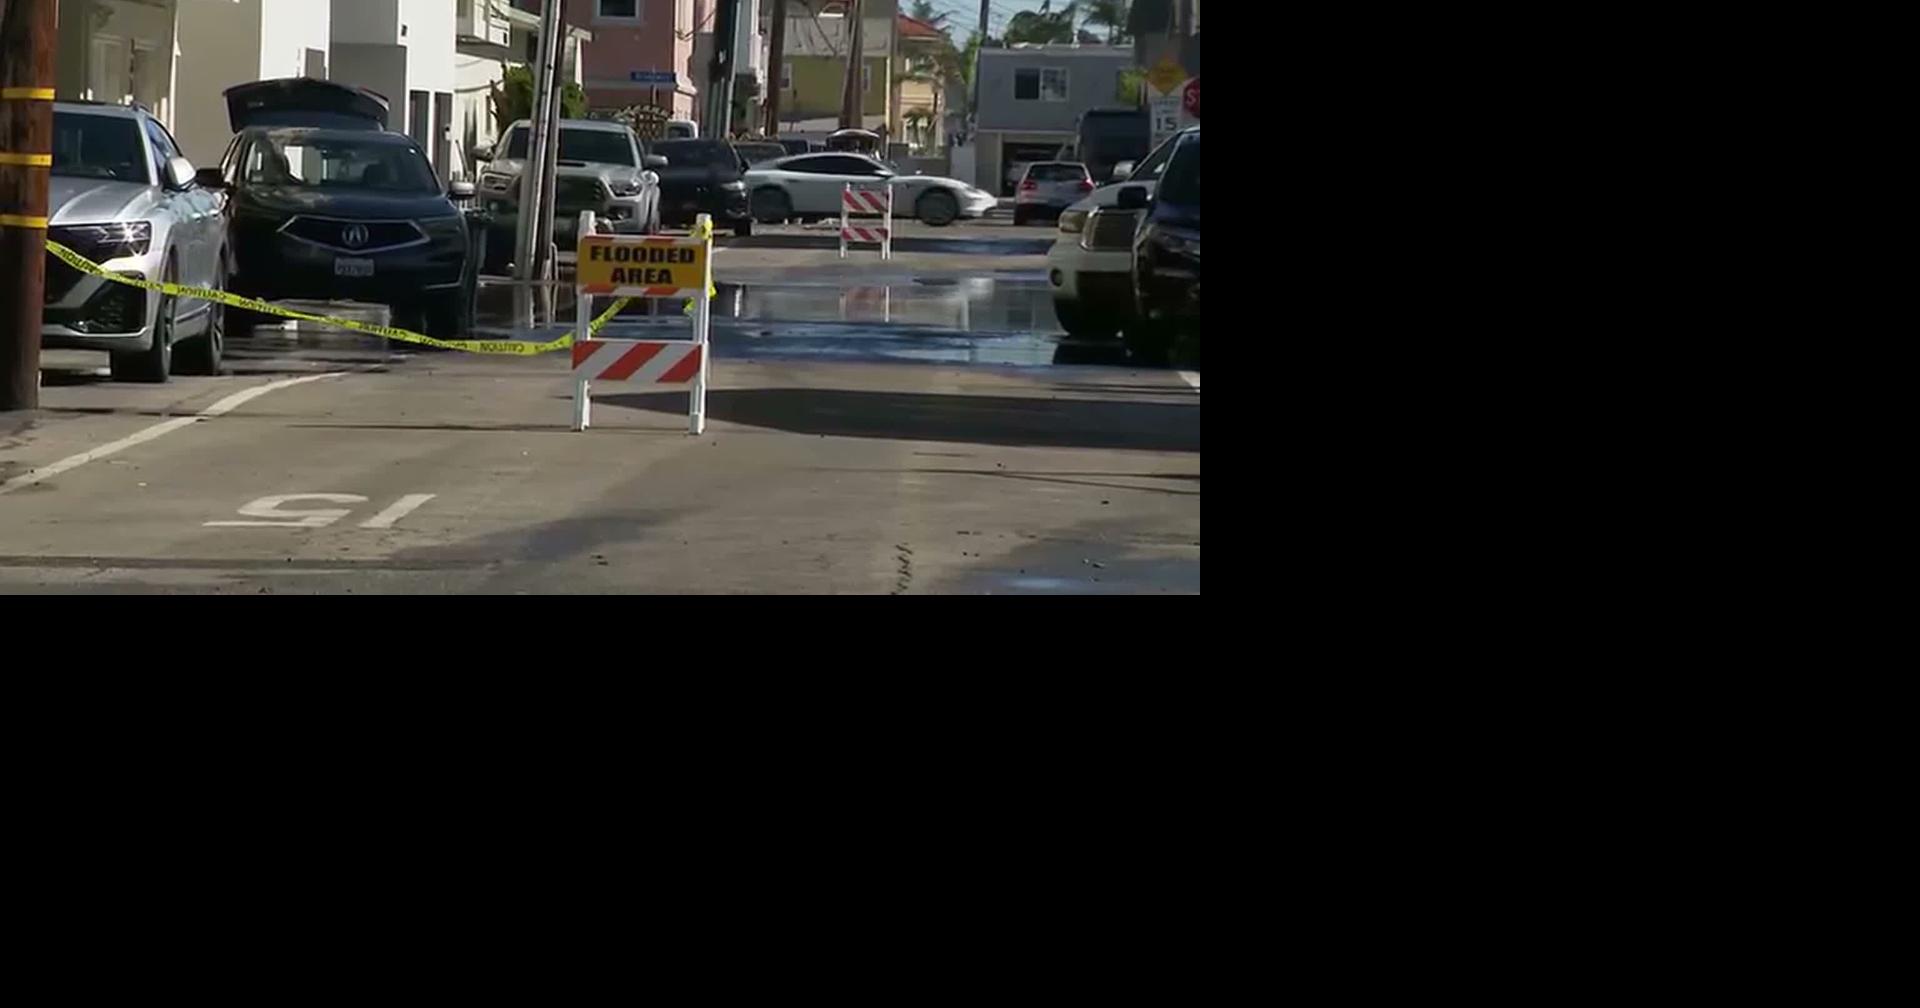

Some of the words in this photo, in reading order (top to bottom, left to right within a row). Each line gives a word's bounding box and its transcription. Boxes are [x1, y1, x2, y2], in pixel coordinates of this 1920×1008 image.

[1156, 118, 1177, 131] 15
[589, 245, 695, 264] FLOODED
[610, 267, 673, 285] AREA
[479, 340, 526, 354] CAUTION
[202, 493, 437, 528] 15
